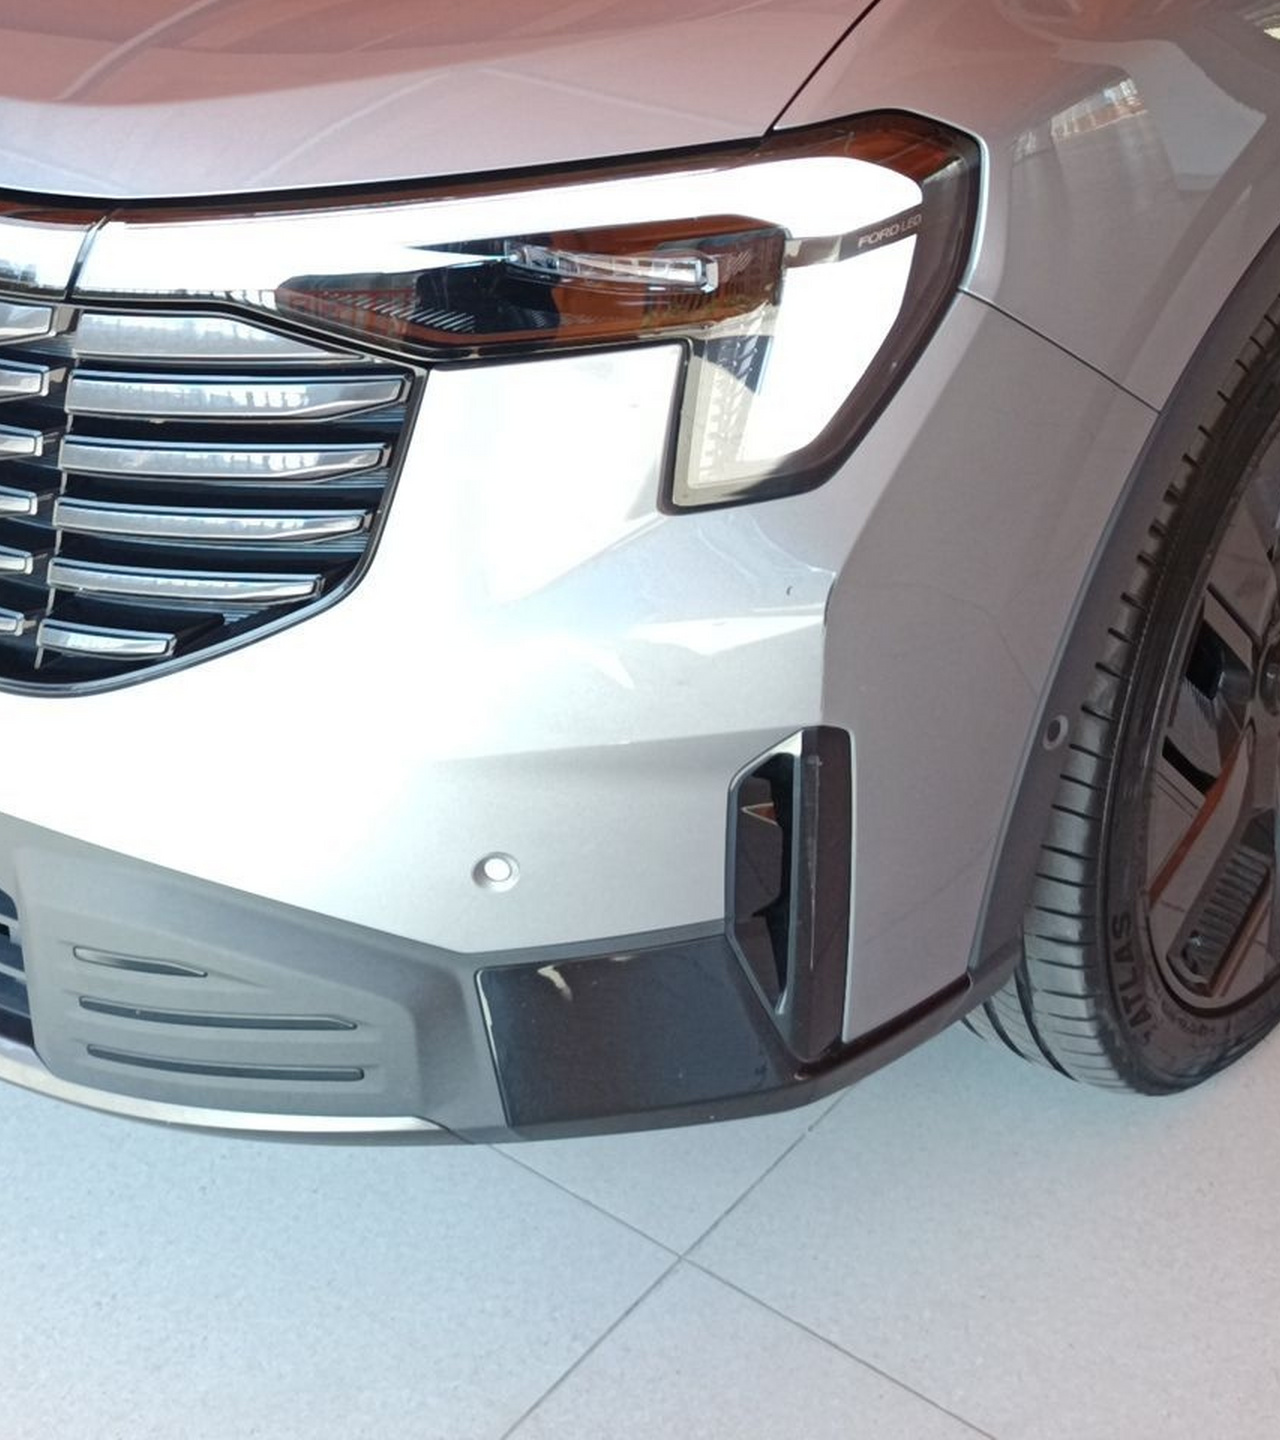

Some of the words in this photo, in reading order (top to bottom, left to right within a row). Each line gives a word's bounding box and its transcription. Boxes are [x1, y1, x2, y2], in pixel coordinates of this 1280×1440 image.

[858, 223, 900, 248] FORD
[902, 213, 922, 231] LED
[1111, 914, 1155, 1027] ATLAS
